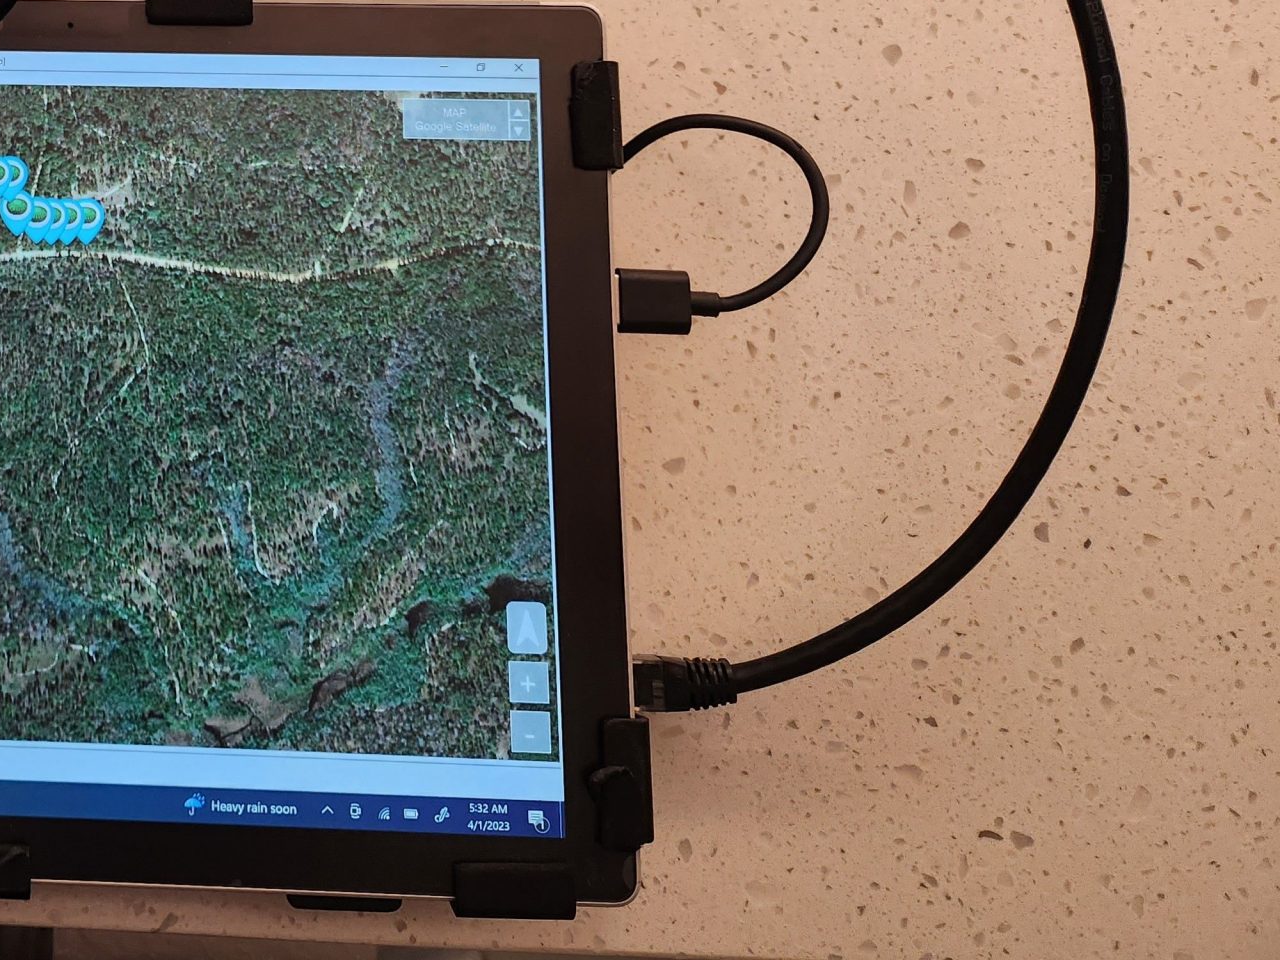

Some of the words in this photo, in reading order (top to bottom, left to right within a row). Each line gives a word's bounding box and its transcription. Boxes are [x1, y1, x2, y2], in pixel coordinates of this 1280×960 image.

[443, 108, 467, 118] MAP
[415, 121, 453, 134] Google
[455, 121, 497, 133] Satellite
[211, 800, 244, 816] Heavy
[246, 801, 268, 815] rain
[271, 805, 297, 815] soon
[469, 803, 489, 814] 5:32
[491, 804, 508, 815] AM
[467, 820, 511, 832] 4/1/2023
